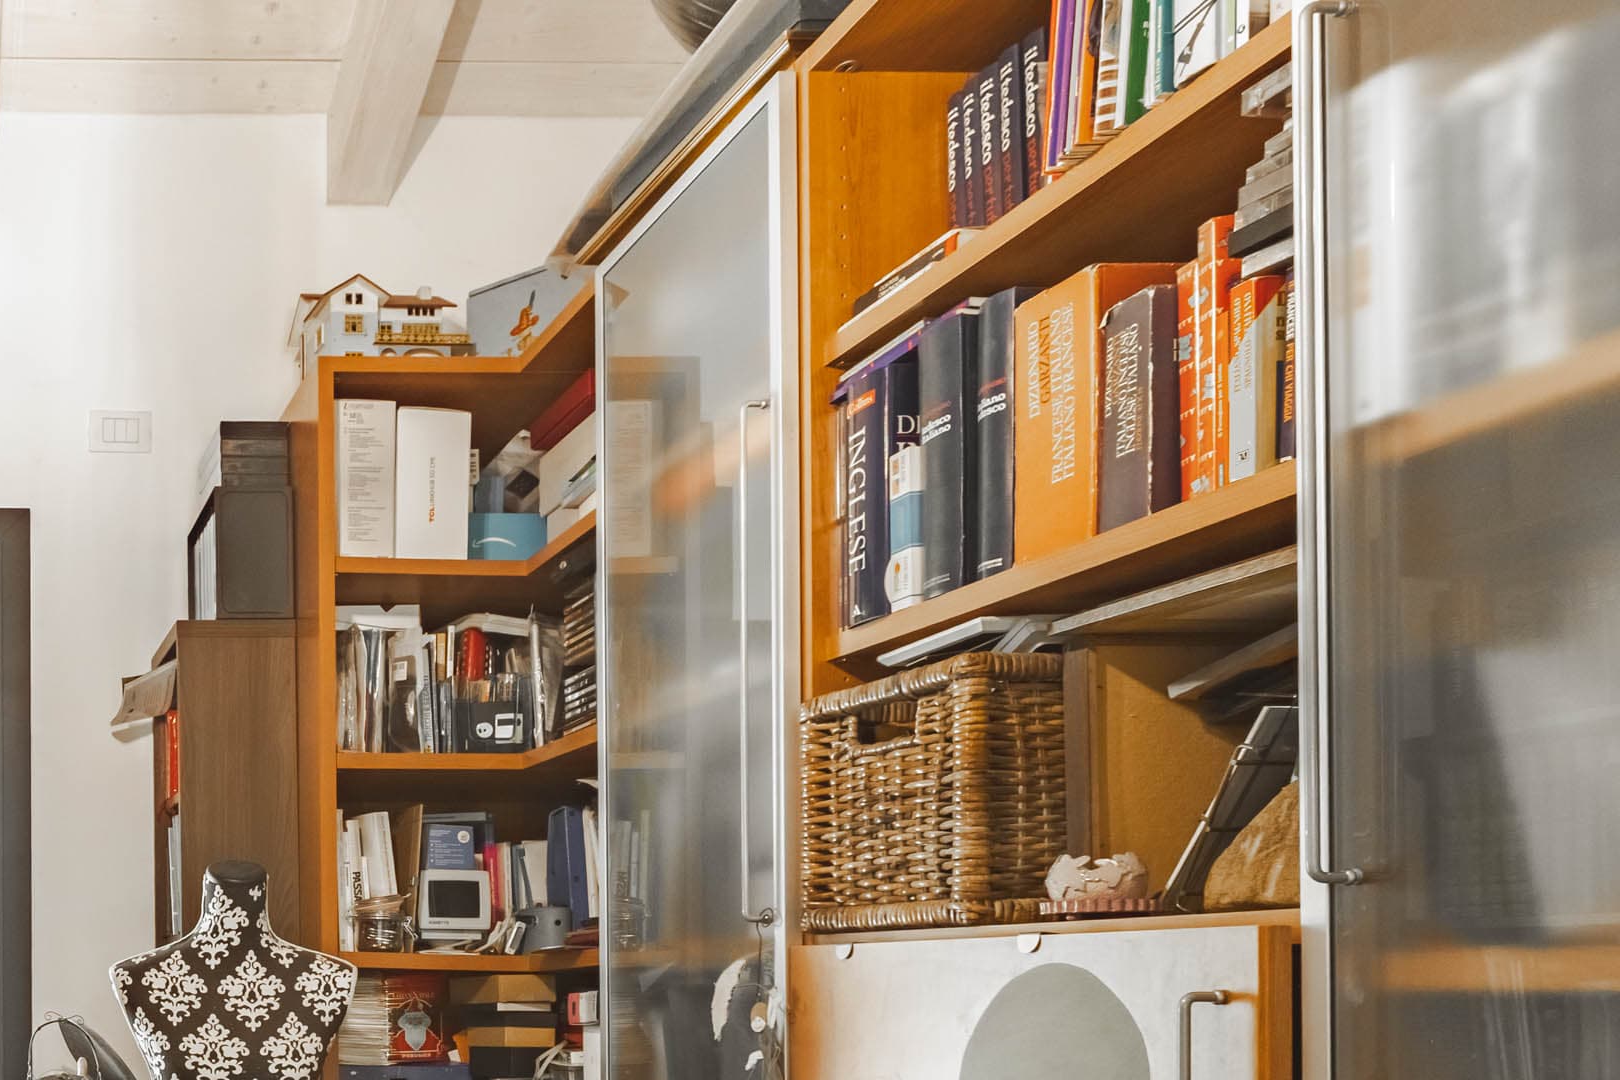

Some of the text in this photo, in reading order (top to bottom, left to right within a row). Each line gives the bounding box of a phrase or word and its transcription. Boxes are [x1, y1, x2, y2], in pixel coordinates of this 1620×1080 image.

[980, 94, 996, 166] tedesco
[1000, 77, 1014, 153] tedesco
[1024, 60, 1039, 138] tedesco
[947, 120, 960, 193] tedesco
[963, 106, 976, 181] tedesco
[1284, 343, 1294, 362] PER
[1285, 292, 1296, 341] FRANCESE
[1028, 321, 1041, 419] DIZIONARIO
[1039, 315, 1050, 405] GARZANTI
[1061, 302, 1075, 479] ITALIANO FRANCESE
[1127, 323, 1139, 393] ITALIANO
[1284, 364, 1294, 382] CHI
[1049, 308, 1063, 485] FRANCESE ITALIANO
[1283, 383, 1294, 423] VIAGGIA
[848, 426, 867, 577] INGLESE
